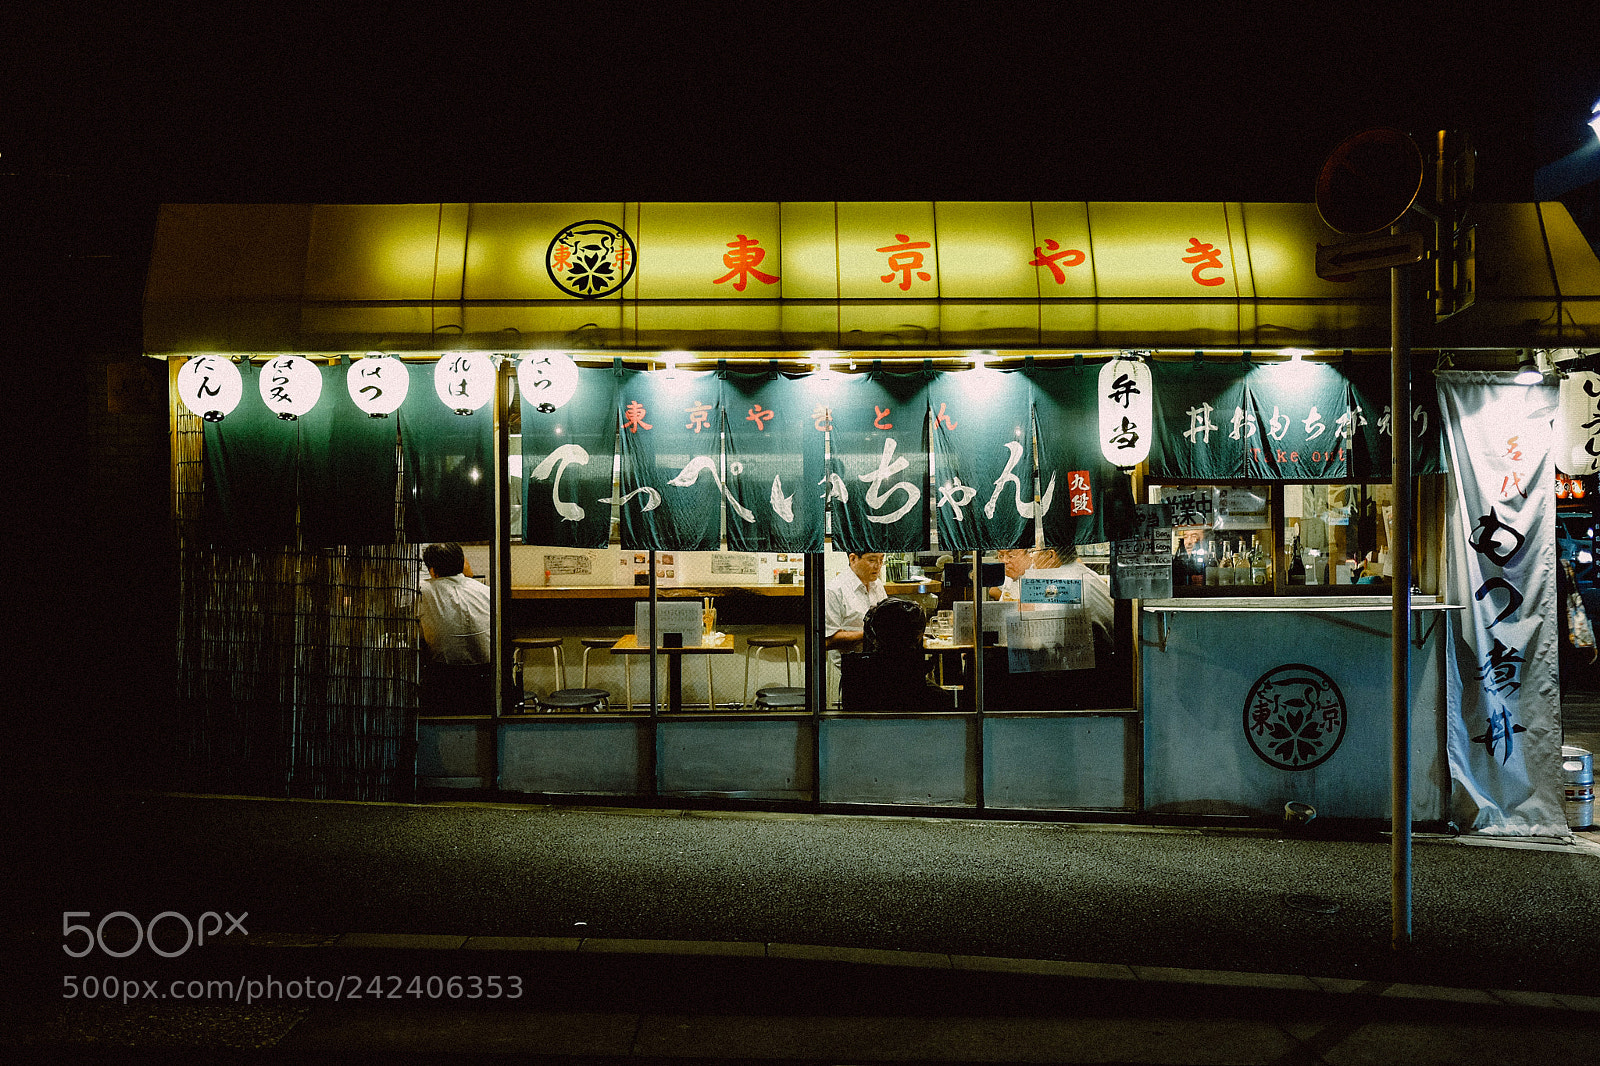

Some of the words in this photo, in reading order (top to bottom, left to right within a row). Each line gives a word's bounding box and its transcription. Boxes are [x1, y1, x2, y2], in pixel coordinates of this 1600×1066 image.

[621, 400, 958, 434] 東京やきとん
[1107, 373, 1141, 449] 弁当
[1249, 447, 1299, 463] Take
[1311, 447, 1346, 463] out
[1070, 473, 1093, 515] 九段
